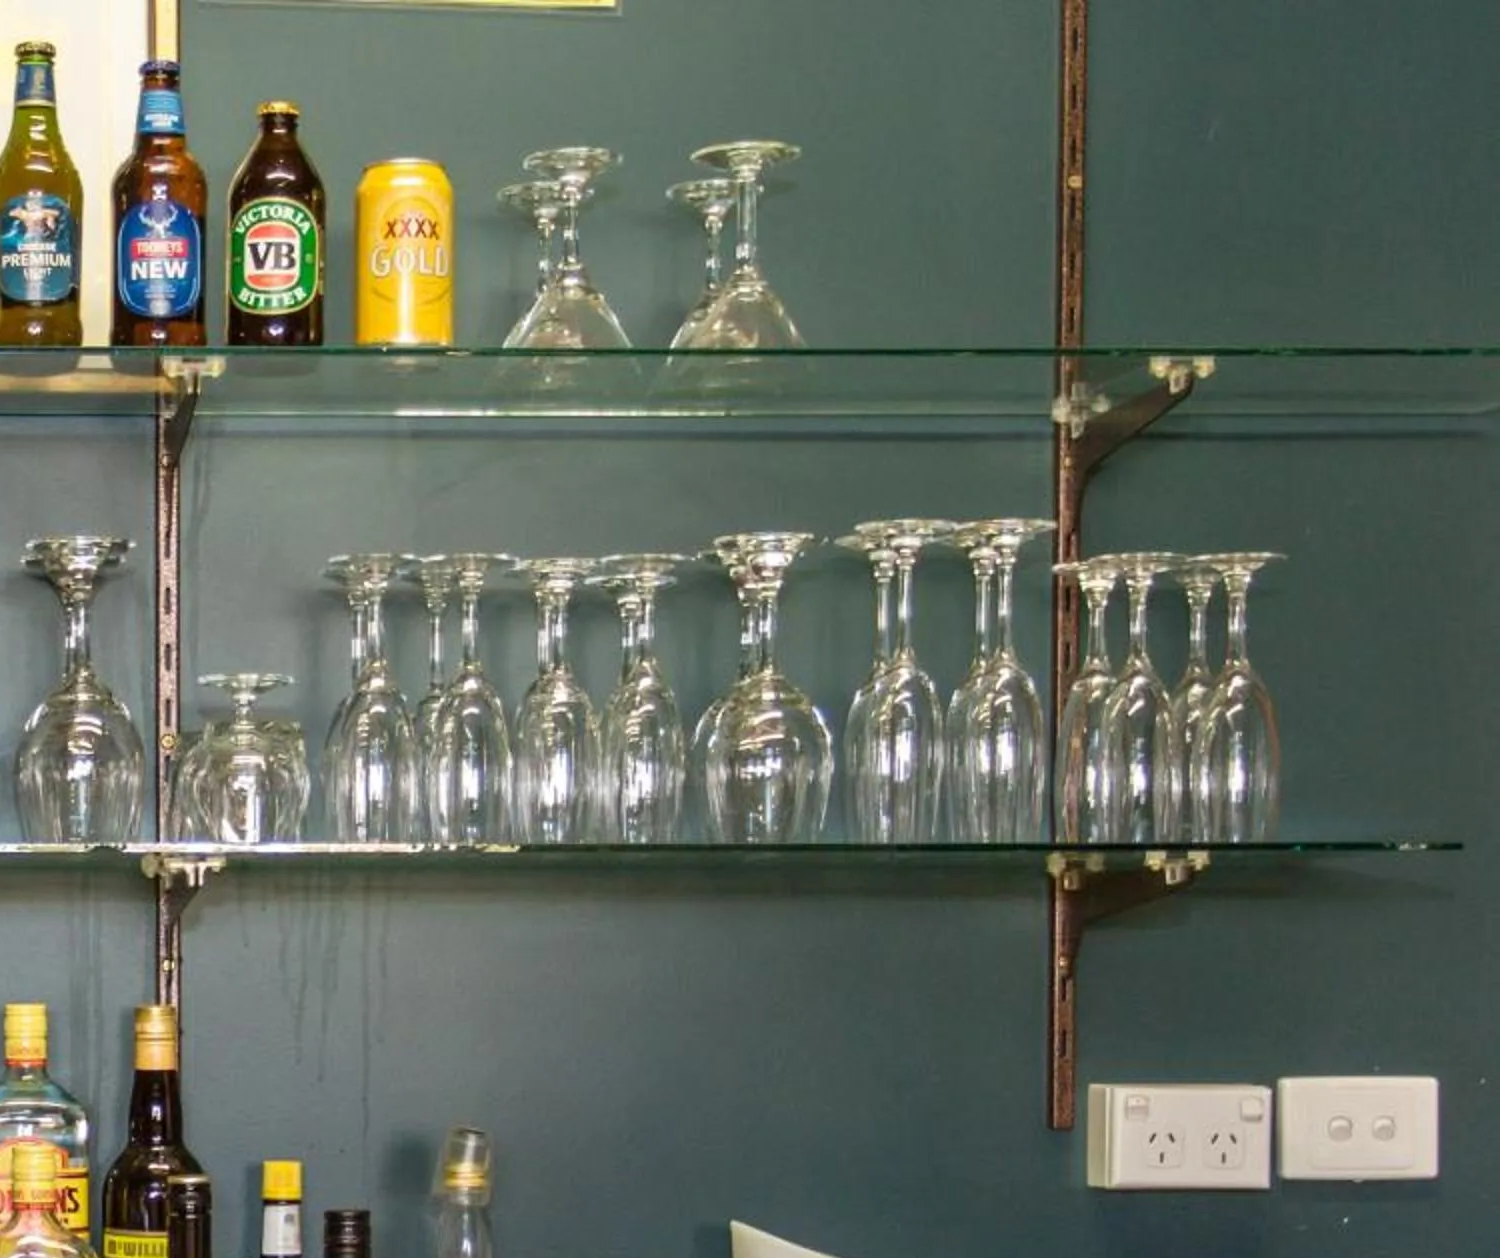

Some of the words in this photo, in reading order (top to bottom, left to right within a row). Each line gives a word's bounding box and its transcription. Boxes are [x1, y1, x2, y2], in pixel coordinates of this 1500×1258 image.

[235, 203, 312, 236] VICTORIA
[384, 218, 440, 241] XXXX
[1, 253, 72, 269] PREMIUM
[247, 242, 296, 271] VB
[370, 244, 449, 278] GOLD
[131, 260, 188, 280] NEW
[237, 287, 308, 309] BITTER
